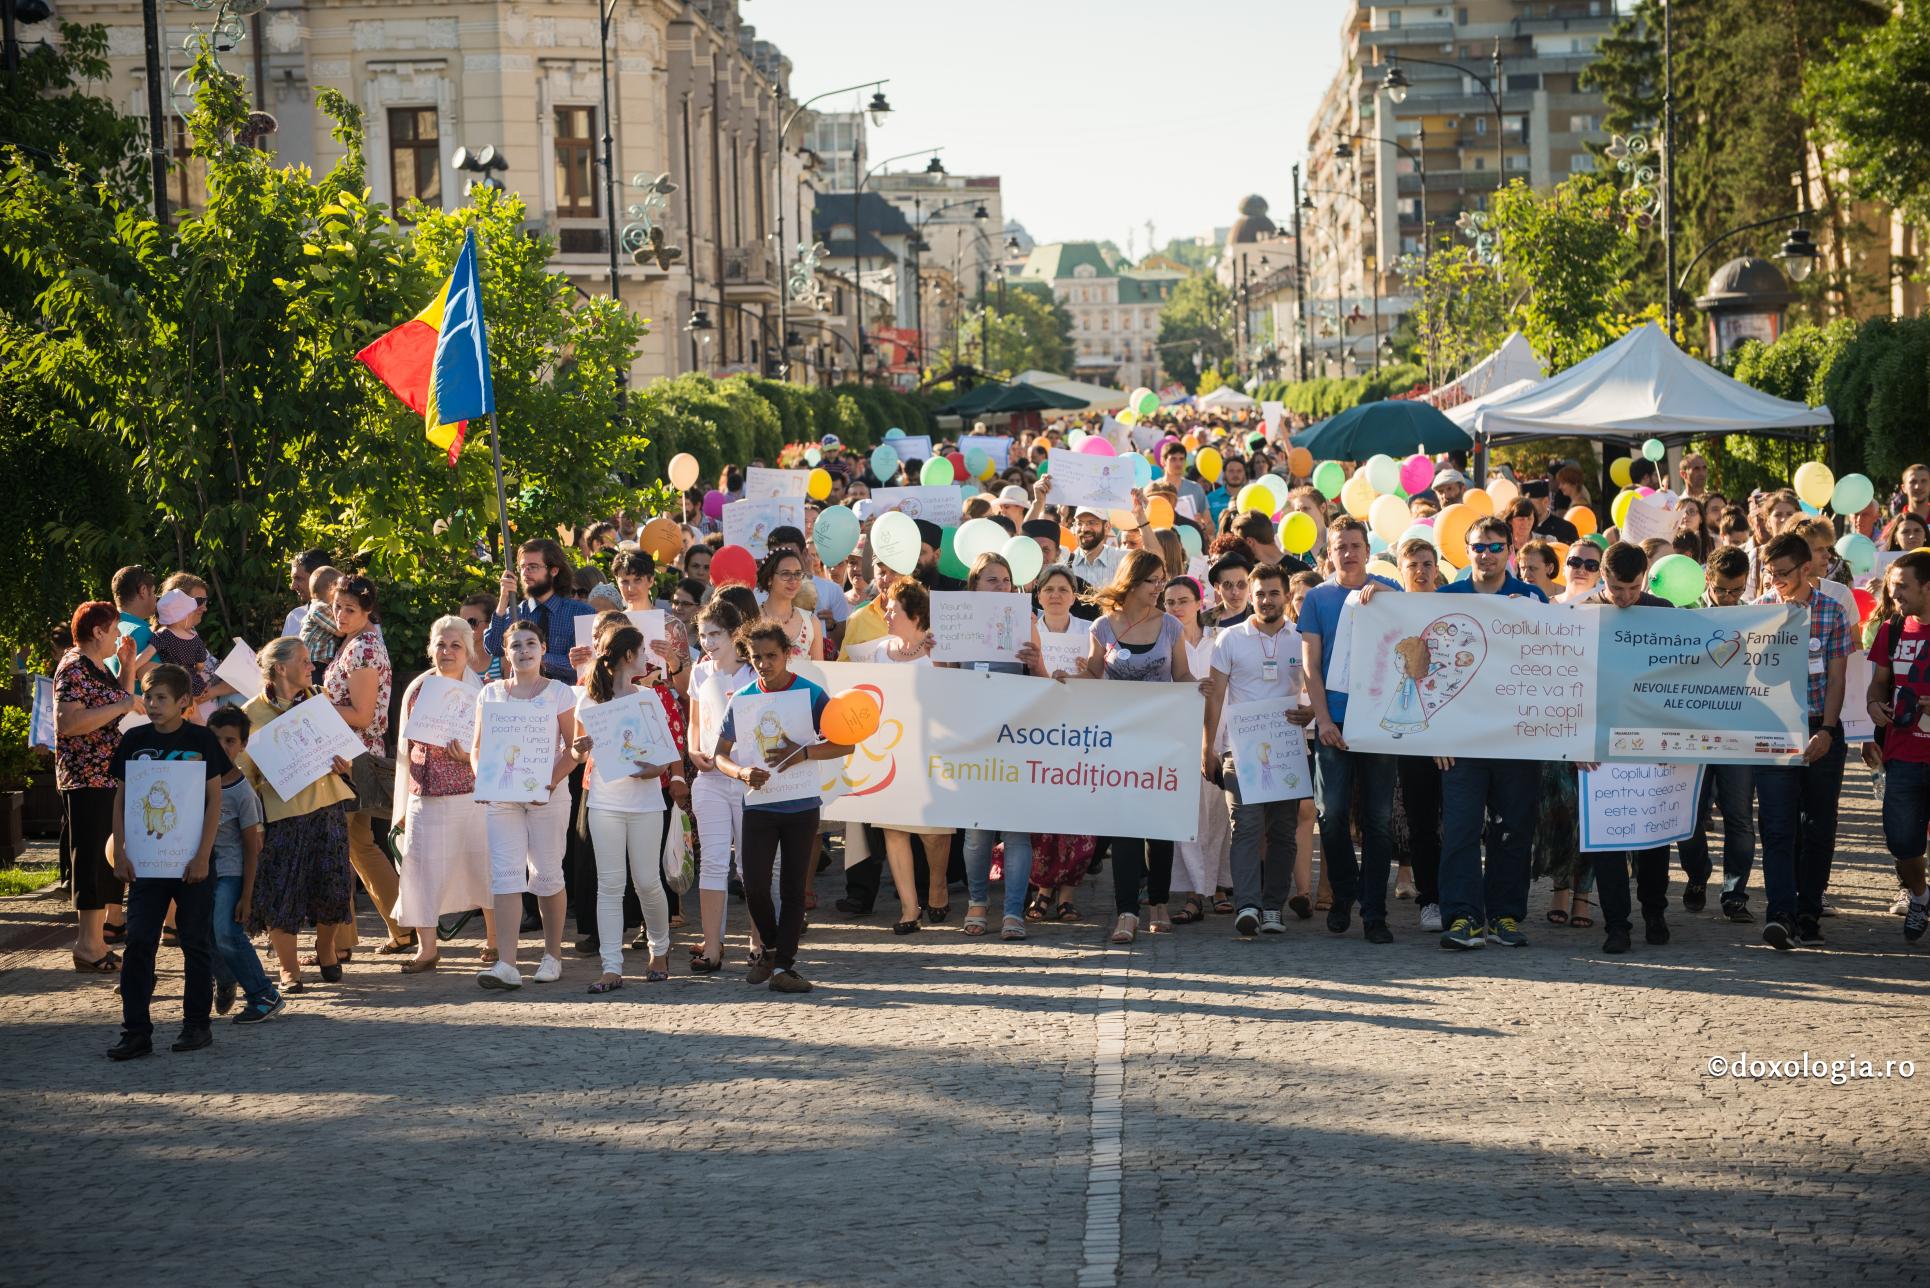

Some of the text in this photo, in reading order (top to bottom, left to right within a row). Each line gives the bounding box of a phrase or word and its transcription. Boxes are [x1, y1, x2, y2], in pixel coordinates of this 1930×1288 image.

[1492, 619, 1585, 639] Copilul iubit
[1614, 630, 1701, 647] Săptămâna
[1747, 631, 1798, 645] Familie
[1521, 641, 1584, 660] pentru
[1648, 653, 1700, 667] pentru
[1743, 653, 1780, 667] 2015
[1510, 664, 1578, 676] ceea ce
[1495, 681, 1584, 698] este va fi
[1633, 682, 1770, 697] NEVOILE FUNDAMENTALE
[1518, 703, 1583, 721] un copil
[1664, 699, 1742, 711] ALE COPILULUI
[492, 724, 545, 735] poate face
[1513, 721, 1577, 737] fericit!
[997, 723, 1112, 754] Asociația
[928, 755, 1178, 793] Familia Tradițională
[1612, 765, 1677, 782] Copilul iubit
[1595, 782, 1687, 801] pentru ceea ce
[1604, 804, 1637, 816] este
[1641, 806, 1657, 816] va
[1669, 801, 1679, 811] un
[1607, 823, 1636, 838] copil
